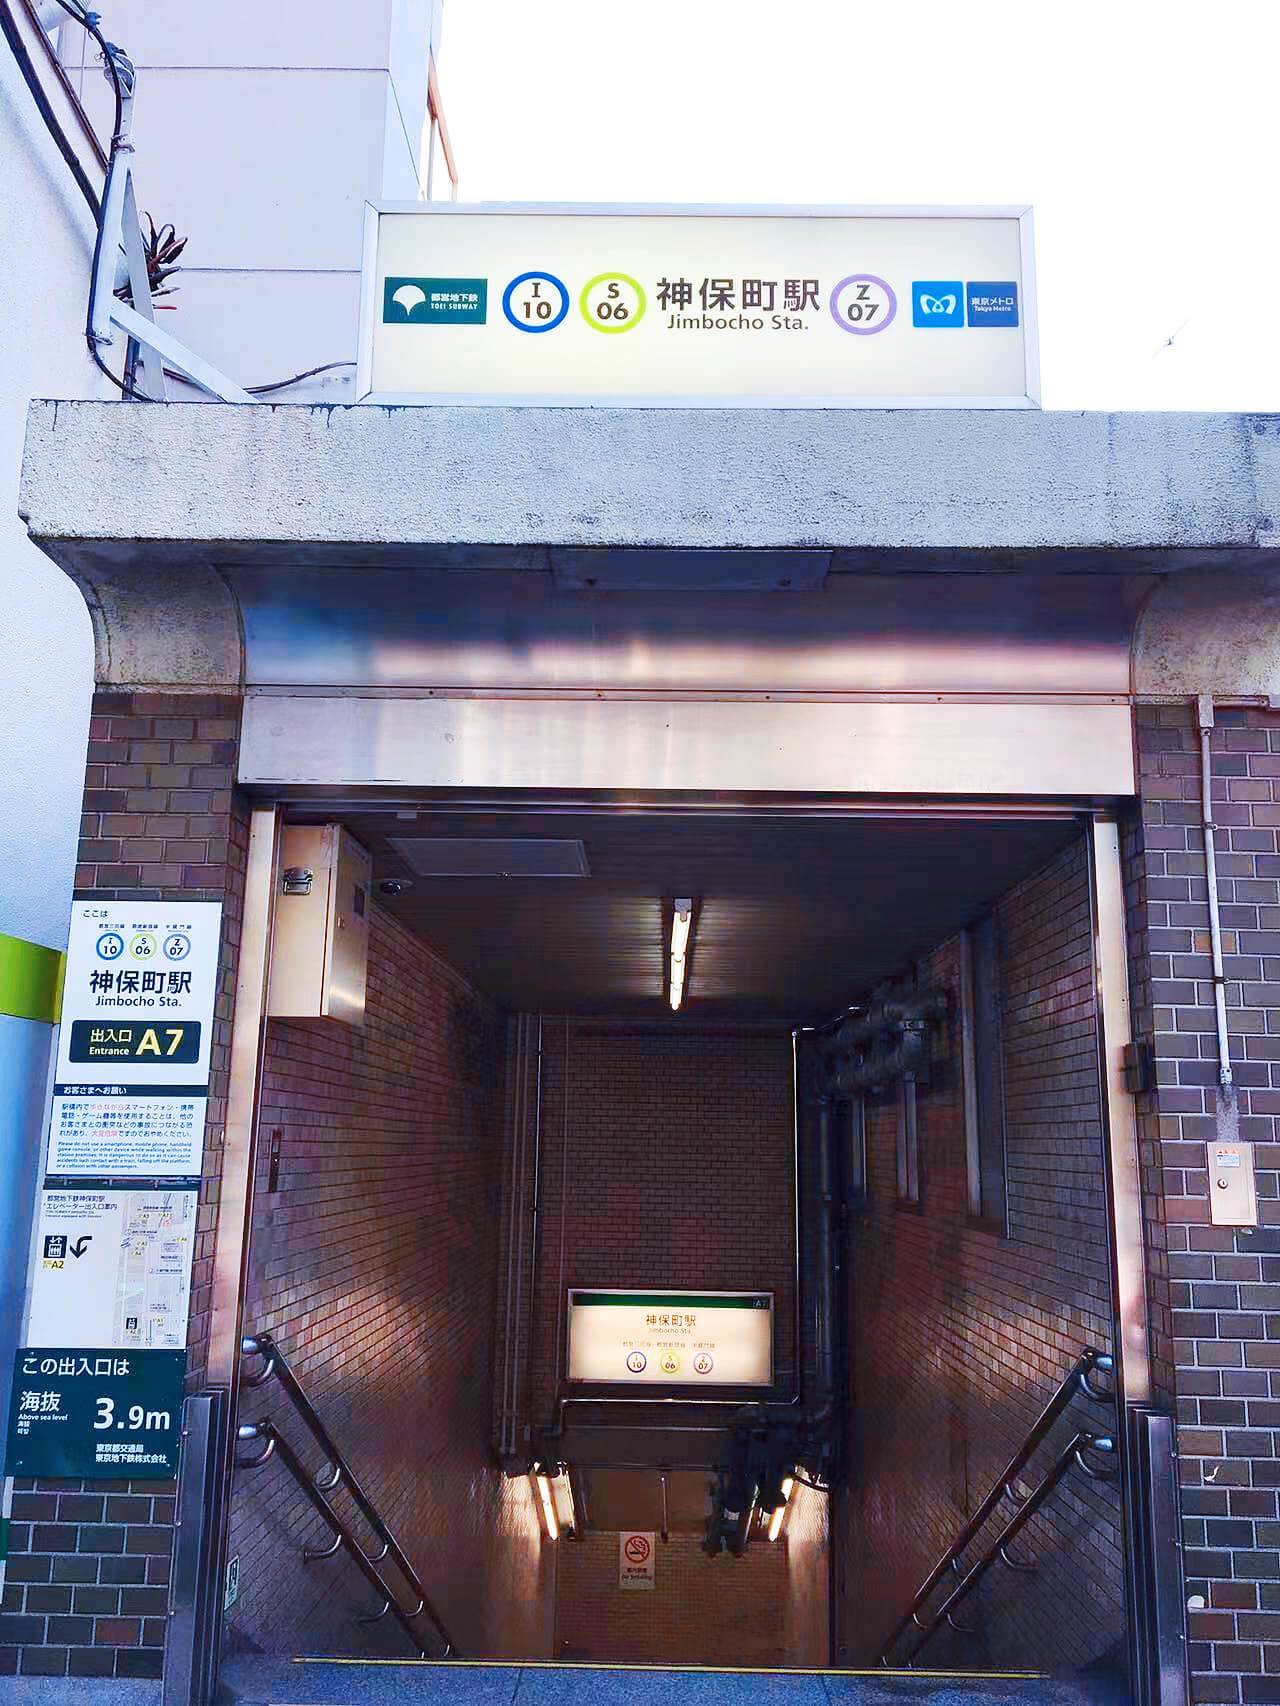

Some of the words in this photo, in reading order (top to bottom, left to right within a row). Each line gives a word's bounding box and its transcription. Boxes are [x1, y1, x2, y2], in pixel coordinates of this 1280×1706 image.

[531, 282, 541, 298] I
[608, 283, 620, 298] S
[656, 277, 821, 312] 神保町駅
[856, 284, 870, 300] Z
[971, 297, 1014, 305] 東京メトロ
[523, 301, 552, 319] 10
[597, 302, 629, 320] 06
[847, 303, 879, 321] 07
[667, 314, 764, 330] Jimbocho
[772, 315, 809, 330] Sta.
[83, 909, 108, 918] ここは
[174, 938, 181, 946] Z
[104, 945, 117, 954] 10
[135, 945, 151, 955] 06
[169, 946, 183, 955] 07
[89, 969, 192, 994] 神保町駅
[95, 996, 155, 1007] Jimbocho
[159, 996, 182, 1007] Sta.
[90, 1028, 133, 1043] 出入口
[135, 1028, 184, 1056] A7
[89, 1046, 130, 1056] Entrance
[63, 1086, 127, 1095] お客さまへお願い
[51, 1260, 64, 1269] A2
[645, 1314, 696, 1327] 神保町駅
[22, 1357, 130, 1376] この出入口は
[632, 1361, 642, 1369] 10
[19, 1390, 61, 1412] 海抜
[52, 1413, 68, 1421] level
[93, 1397, 170, 1430] 3.9m
[96, 1443, 144, 1453] 東京都交通局
[95, 1454, 168, 1464] 東京地下鉄株式会社
